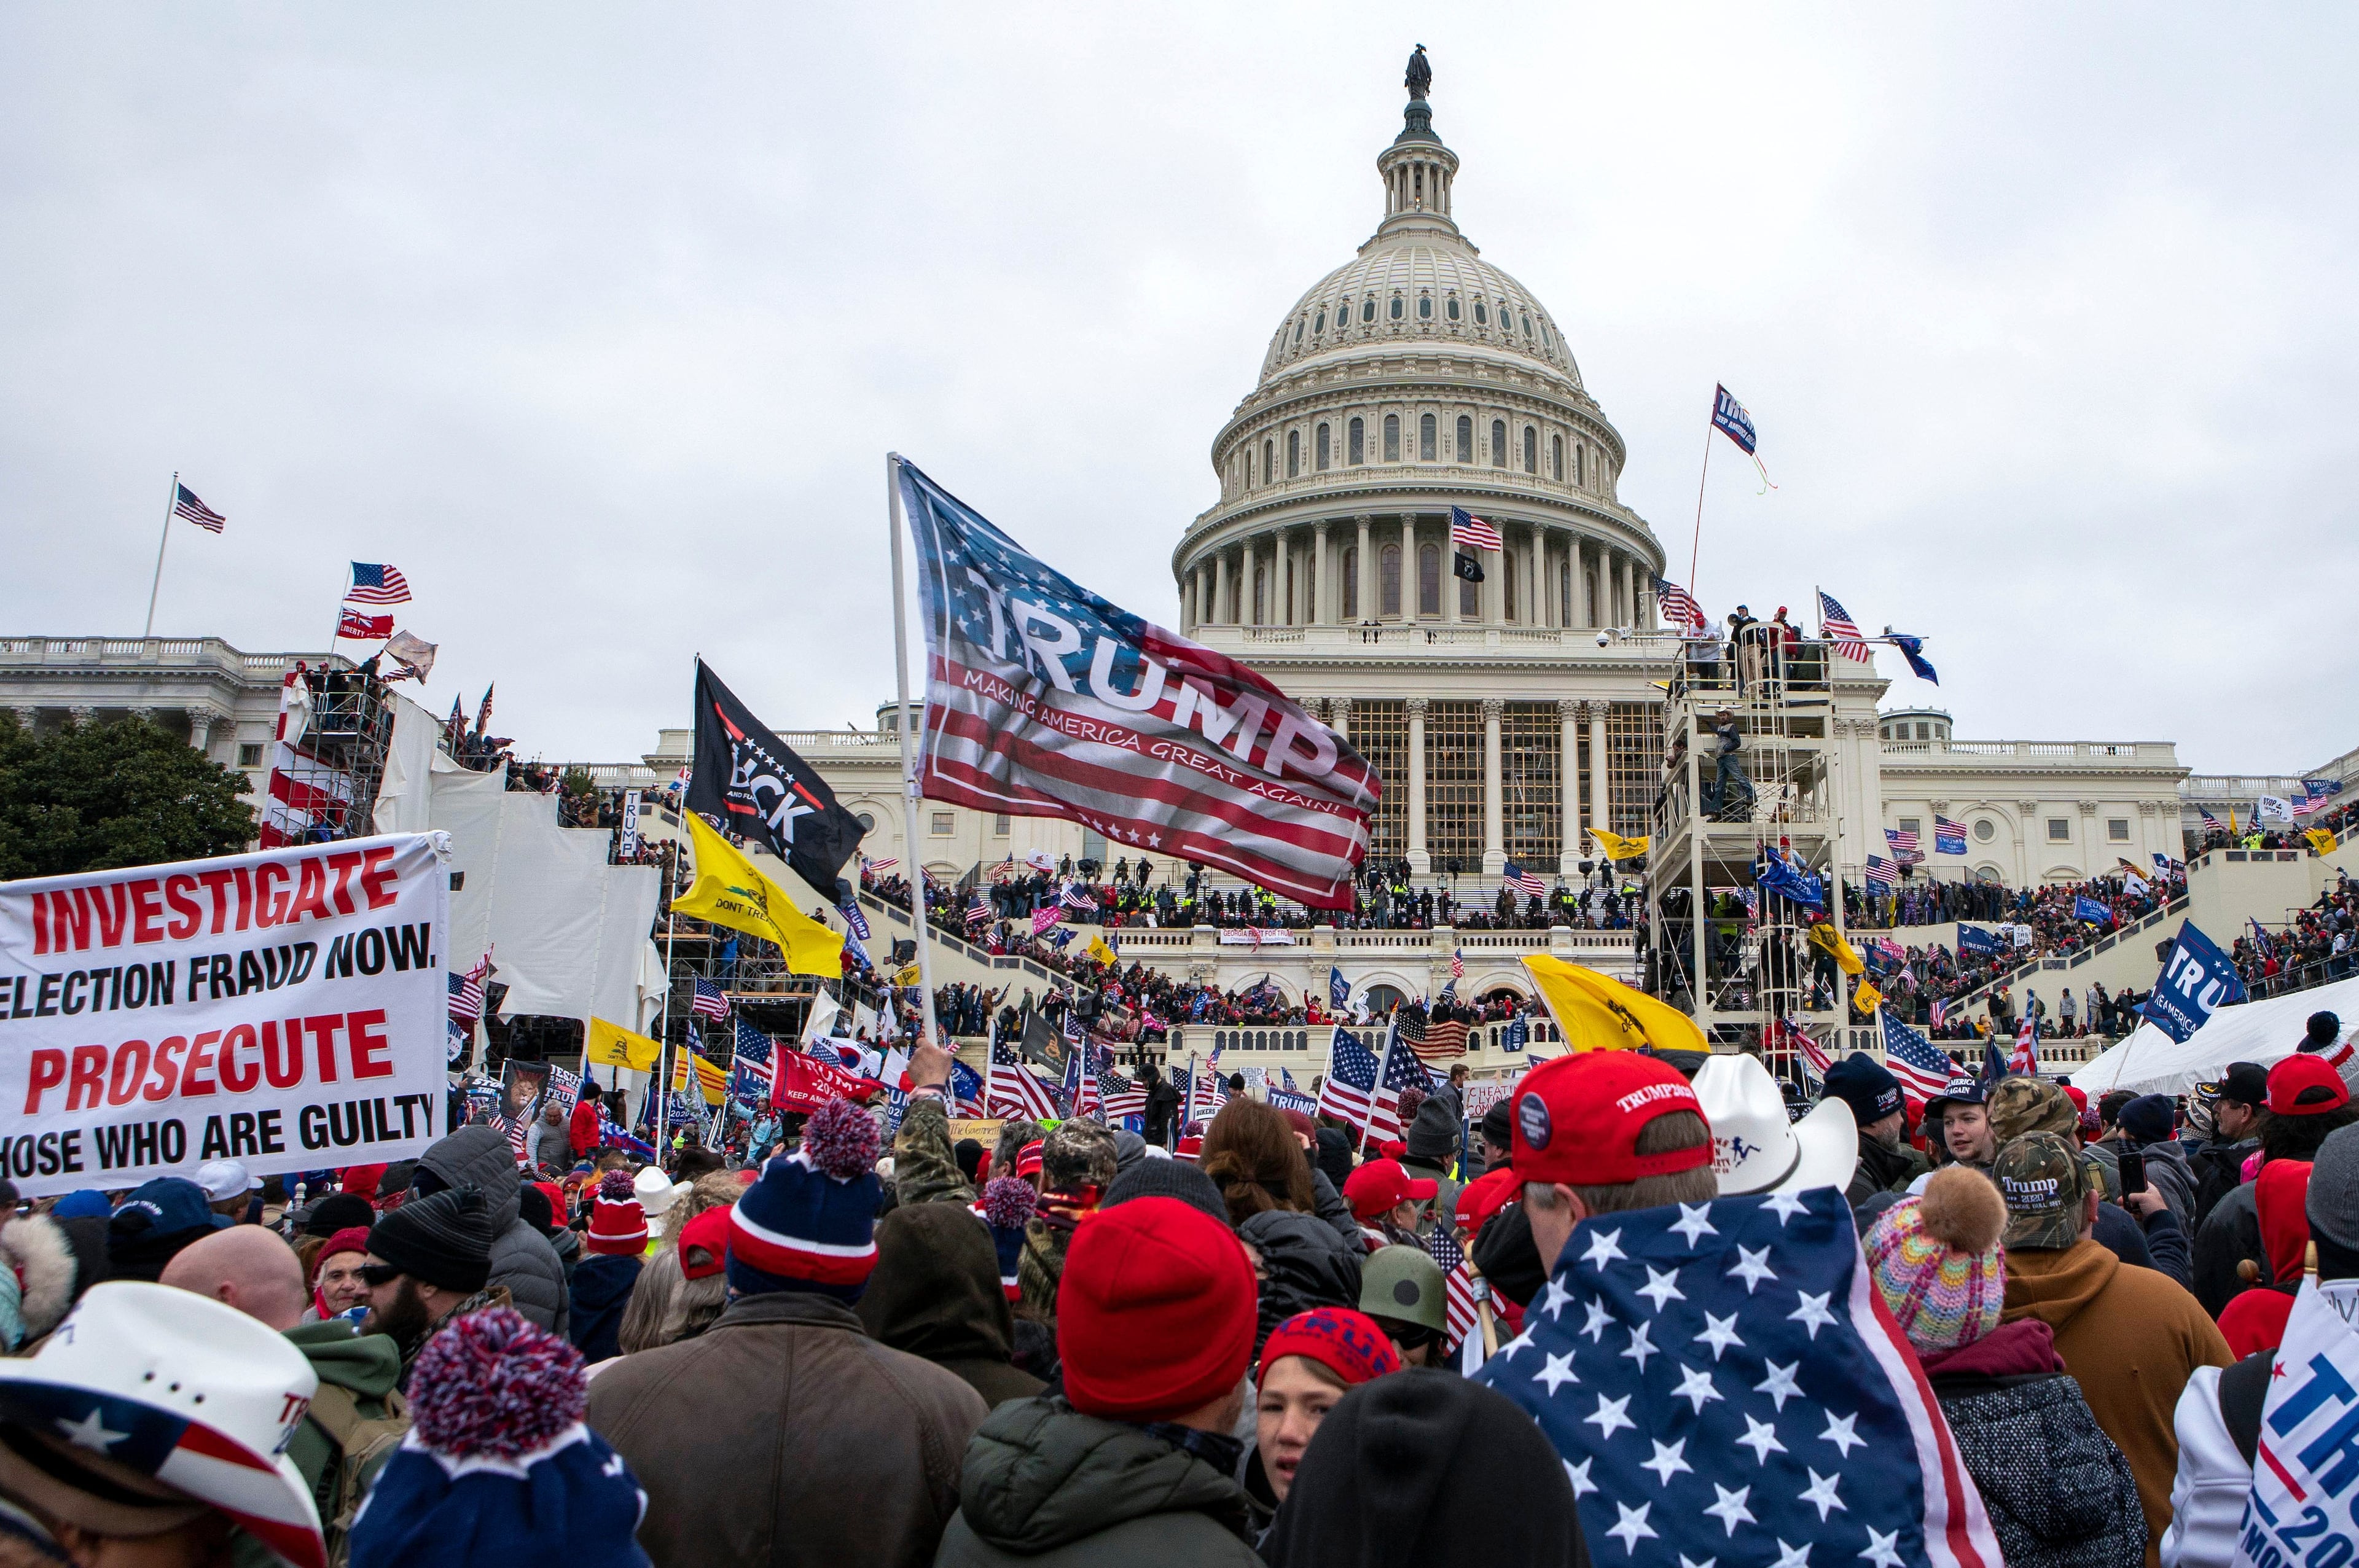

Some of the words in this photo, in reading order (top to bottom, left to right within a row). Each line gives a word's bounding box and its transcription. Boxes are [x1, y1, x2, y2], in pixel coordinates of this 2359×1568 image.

[340, 625, 366, 638] LIBERTY
[966, 567, 1339, 778] TRUMP
[963, 669, 1036, 719] MAKING
[1039, 709, 1141, 753] AMERICA
[1150, 741, 1243, 784] GREAT
[1247, 779, 1341, 816] AGAIN!
[2263, 798, 2277, 806] STOP
[623, 793, 638, 856] TRUMP
[1938, 837, 1964, 845] TRUMP
[31, 846, 401, 956] INVESTIGATE
[716, 899, 744, 913] DONT
[2081, 900, 2110, 914] TRUMP
[847, 902, 867, 938] TRUMP
[1962, 940, 1992, 953] LIBERTY
[188, 942, 318, 1002] FRAUD
[324, 922, 436, 979] NOW.
[2166, 945, 2228, 1015] TRU
[23, 1009, 397, 1115] PROSECUTE
[550, 1064, 585, 1088] JESUS
[951, 1067, 970, 1082] 2ND
[788, 1090, 808, 1100] KEEP
[1875, 1088, 1898, 1103] Trump
[1196, 1108, 1216, 1117] BIKERS
[1271, 1094, 1316, 1115] TRUMP
[94, 1118, 187, 1169] WHO
[200, 1109, 286, 1161] ARE
[299, 1093, 434, 1151] GUILTY
[950, 1123, 964, 1135] The
[964, 1121, 1000, 1136] Government
[2002, 1176, 2058, 1196] Trump
[2021, 1194, 2044, 1203] 2020
